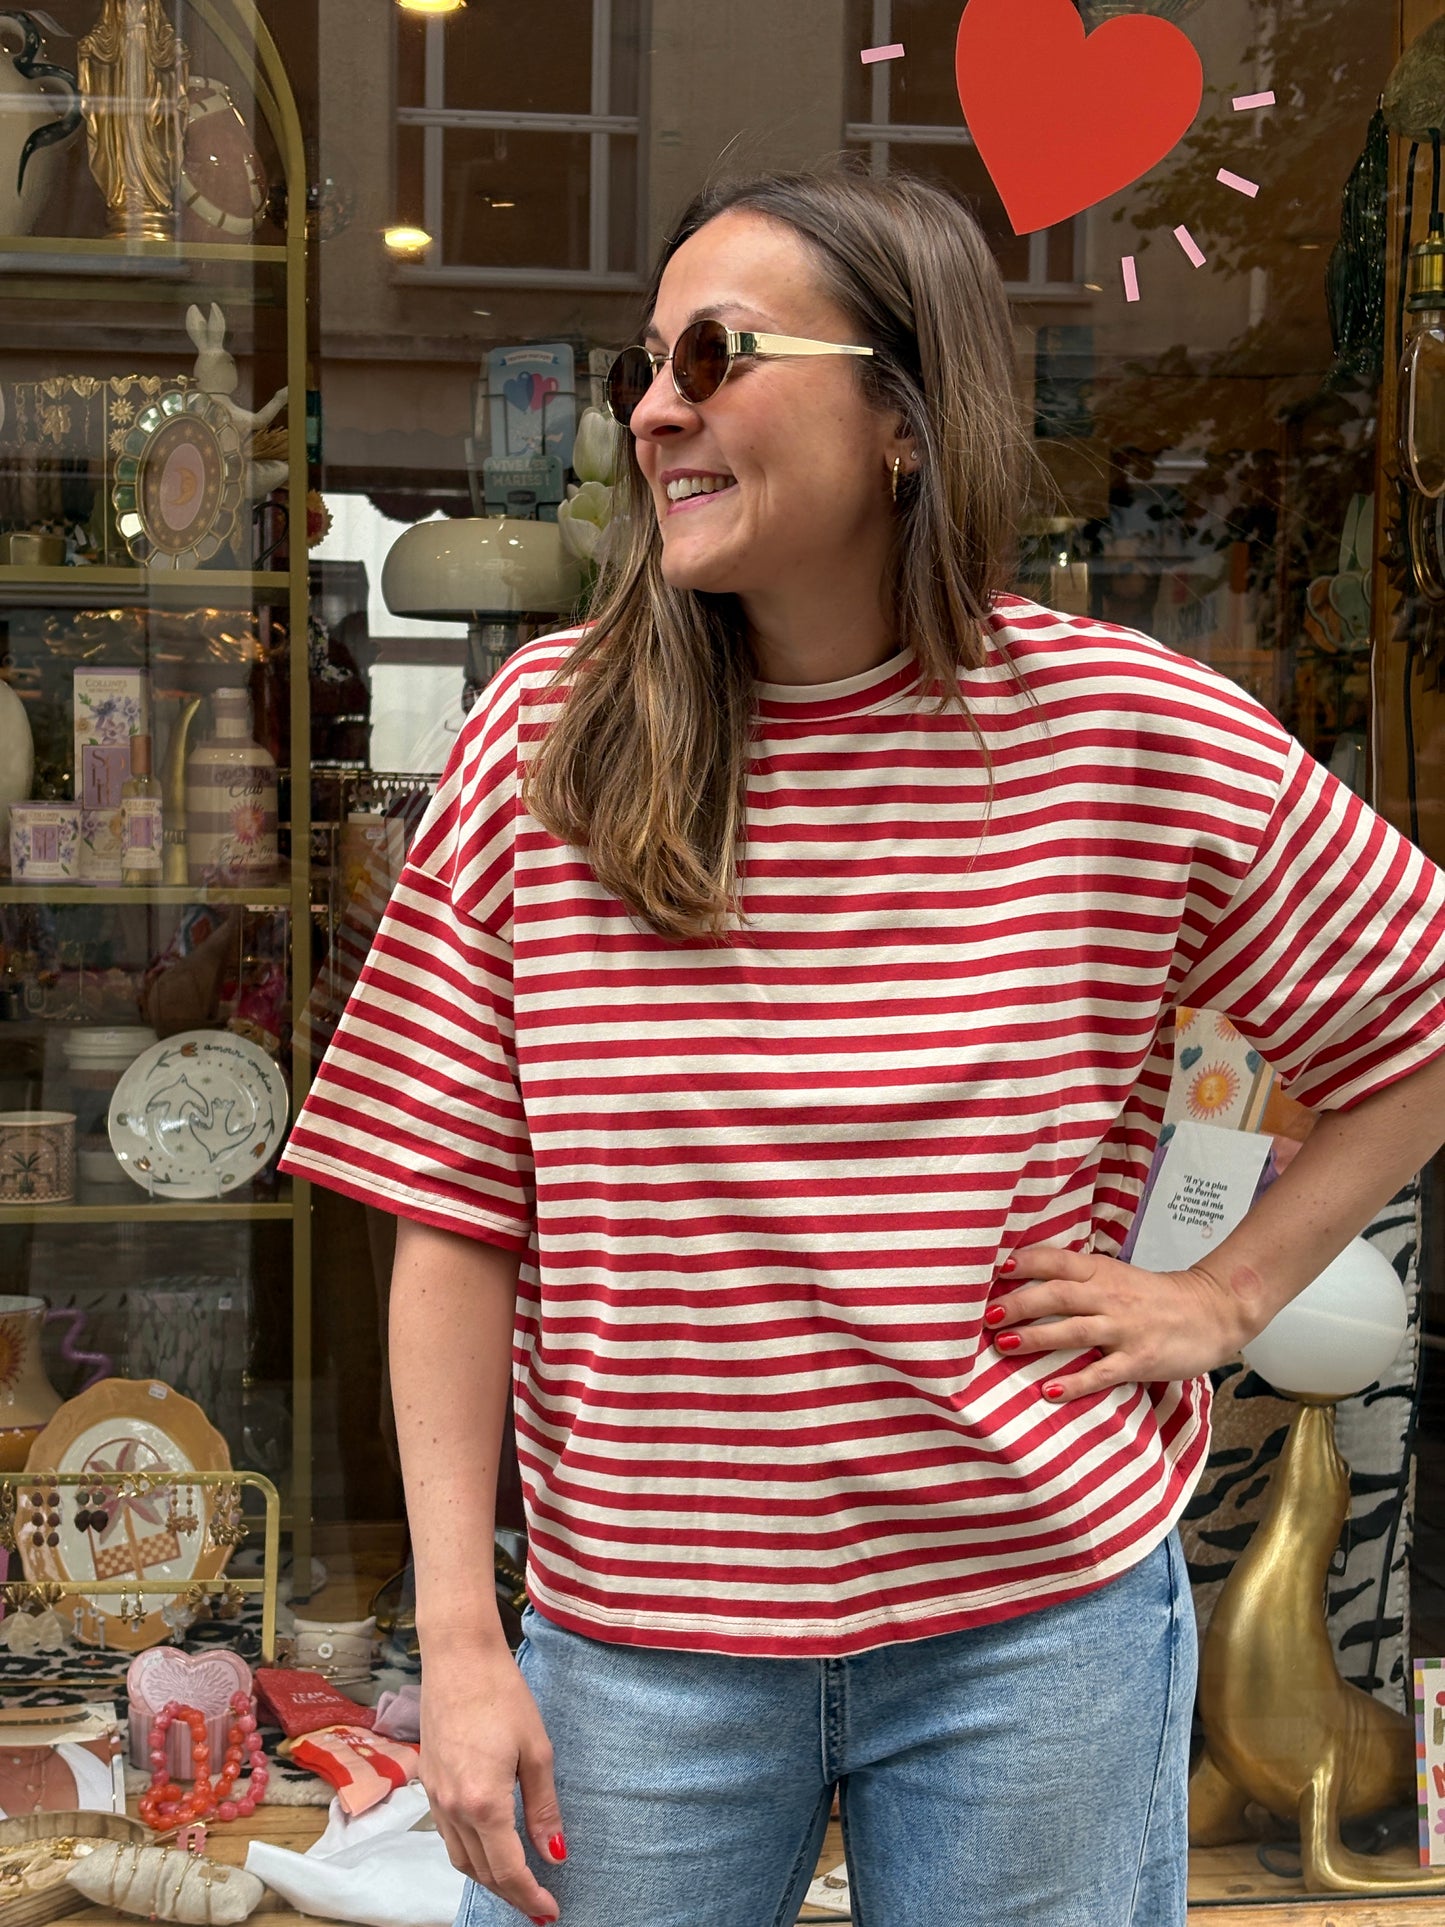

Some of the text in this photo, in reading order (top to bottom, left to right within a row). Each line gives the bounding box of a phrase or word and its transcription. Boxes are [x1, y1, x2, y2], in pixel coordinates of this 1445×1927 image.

[203, 1043, 245, 1058] amour
[1183, 1185, 1221, 1200] de Perrier
[1210, 1181, 1228, 1191] plus
[1171, 1192, 1224, 1211] je vous ai mis
[1167, 1201, 1225, 1221] du Champagne
[1172, 1212, 1178, 1220] à
[1178, 1212, 1186, 1222] la
